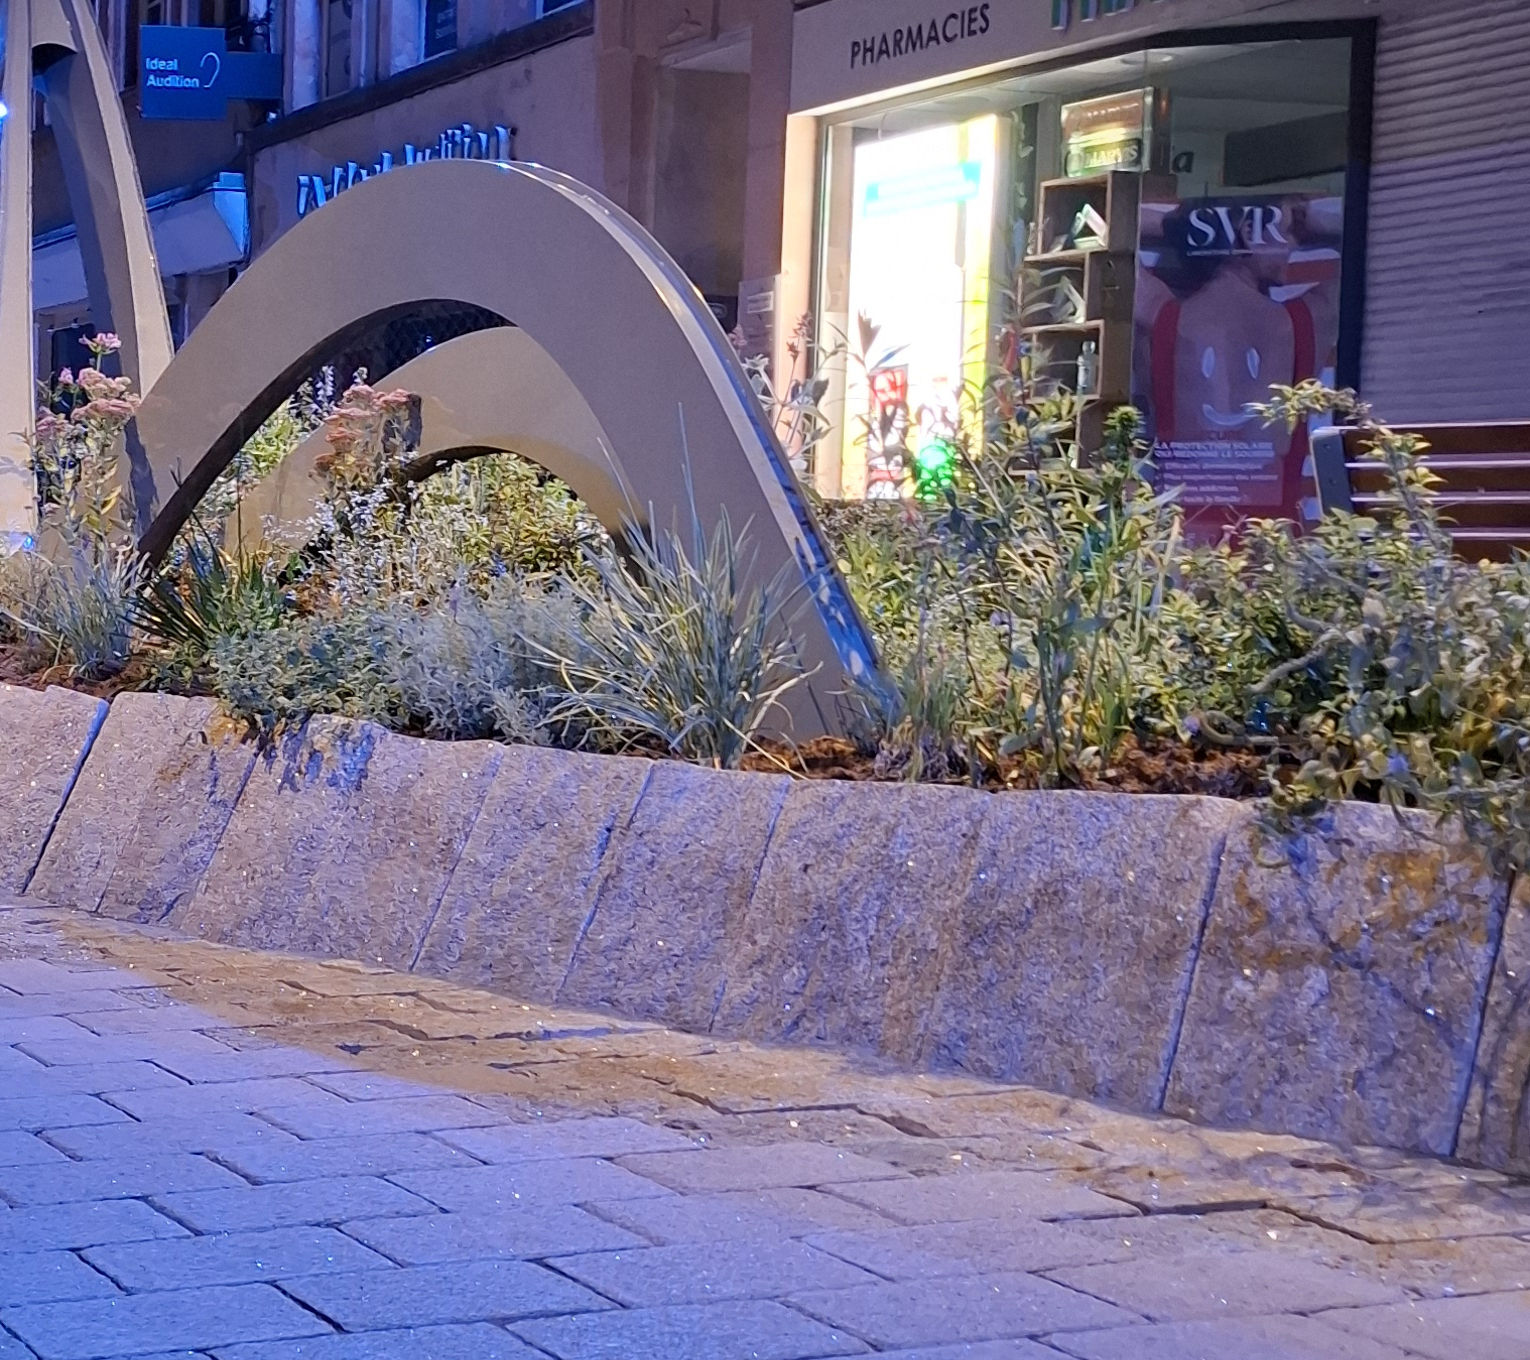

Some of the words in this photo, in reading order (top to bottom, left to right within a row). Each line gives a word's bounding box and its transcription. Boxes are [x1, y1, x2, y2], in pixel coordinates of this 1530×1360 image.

[850, 2, 990, 69] PHARMACIES
[145, 58, 178, 71] Ideal
[146, 74, 200, 88] Audition
[1186, 205, 1289, 248] SVR
